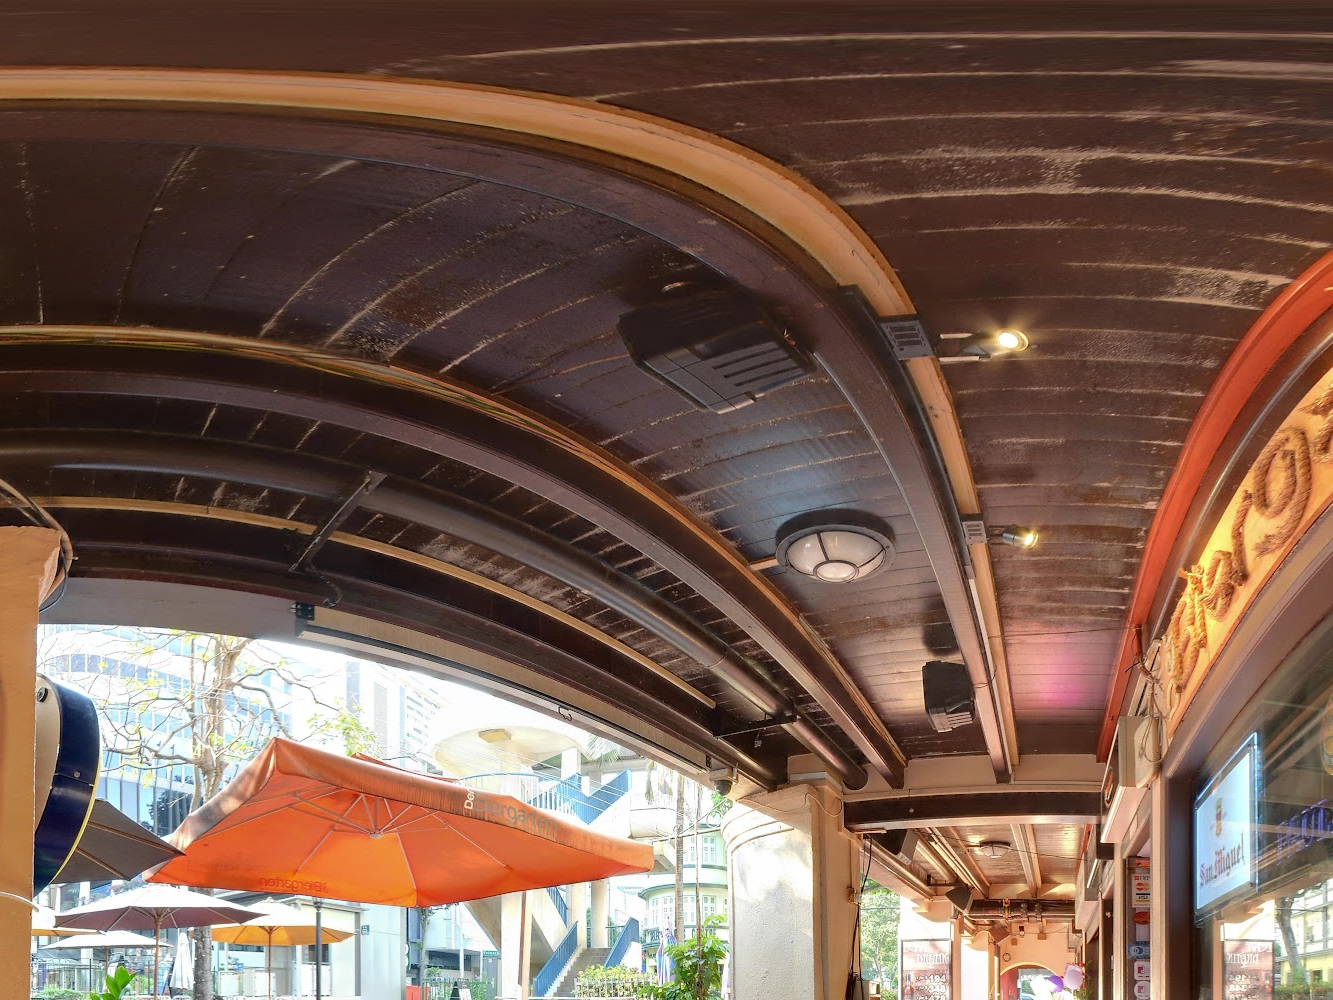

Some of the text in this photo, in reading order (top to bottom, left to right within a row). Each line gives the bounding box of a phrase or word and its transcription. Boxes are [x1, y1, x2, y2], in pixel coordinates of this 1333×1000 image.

[464, 788, 558, 833] Der Biergarten
[1213, 831, 1245, 879] Miguel
